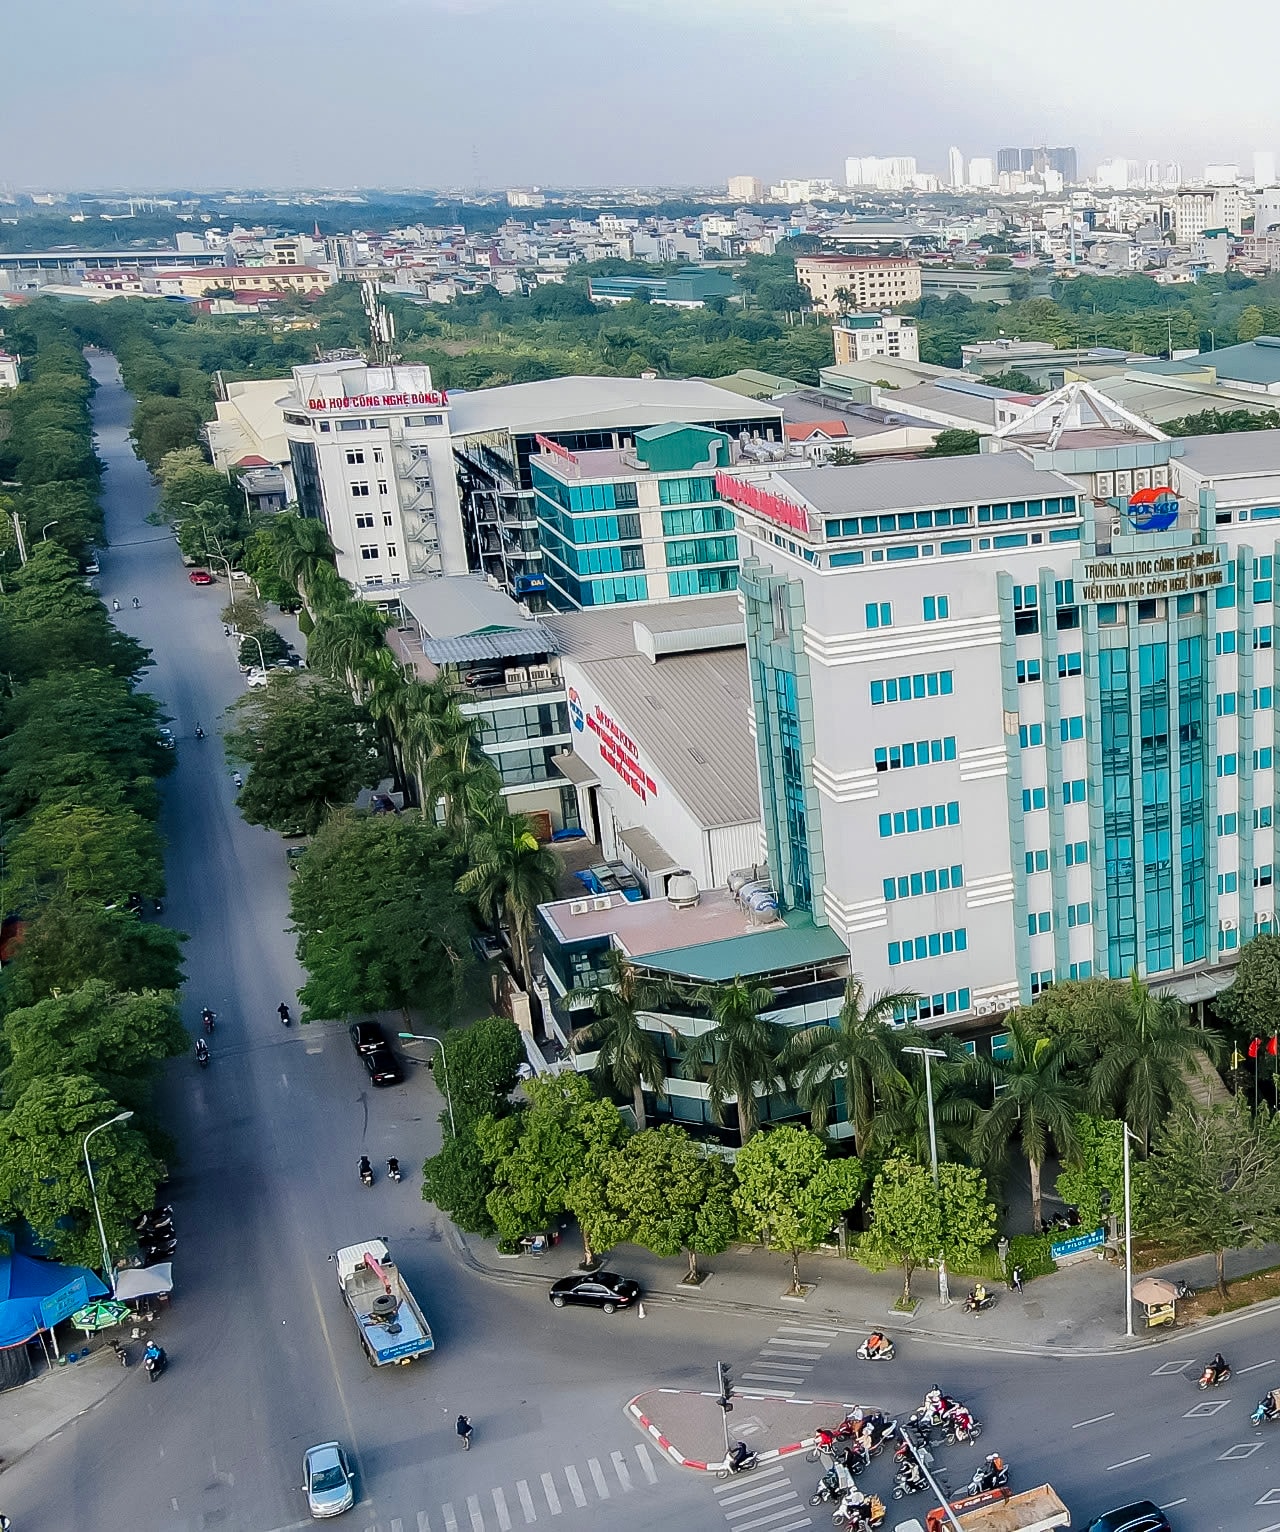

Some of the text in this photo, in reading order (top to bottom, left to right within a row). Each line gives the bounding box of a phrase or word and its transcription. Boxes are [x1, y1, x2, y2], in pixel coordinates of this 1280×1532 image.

[382, 392, 409, 407] NGHỆ
[1084, 560, 1118, 579] TRƯỜNG
[1120, 561, 1135, 578] ĐẠI
[1135, 560, 1152, 577] HỌC
[1153, 555, 1175, 572] CÔNG
[1083, 582, 1101, 602] VIỆN
[1103, 582, 1126, 600] KHOA
[1128, 579, 1144, 597] HỌC
[1146, 577, 1168, 594] CÔNG
